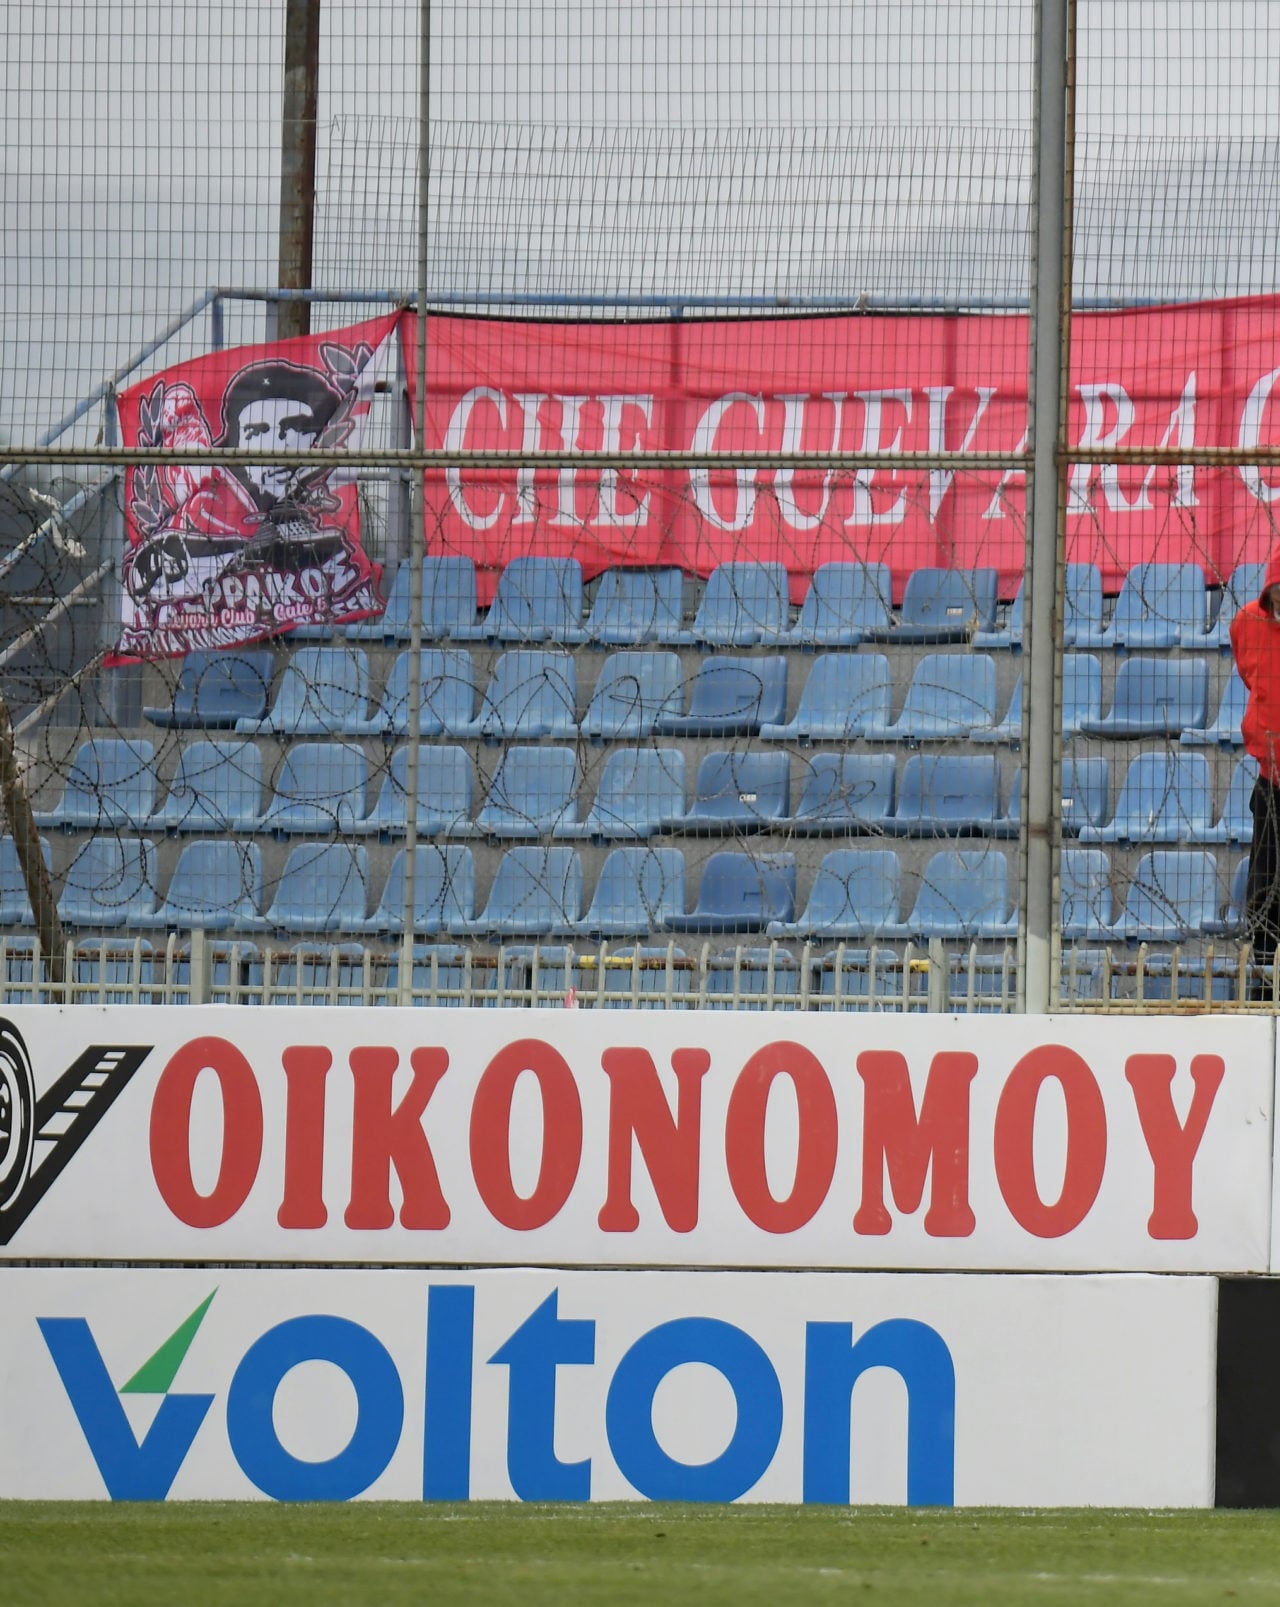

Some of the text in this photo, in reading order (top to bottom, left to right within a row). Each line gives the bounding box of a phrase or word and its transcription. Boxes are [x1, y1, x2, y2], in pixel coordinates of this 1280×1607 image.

[442, 386, 654, 529] CHE
[150, 1036, 1225, 1240] ΟΙΚΟΝΟΜΟΥ
[35, 1284, 957, 1507] volton
